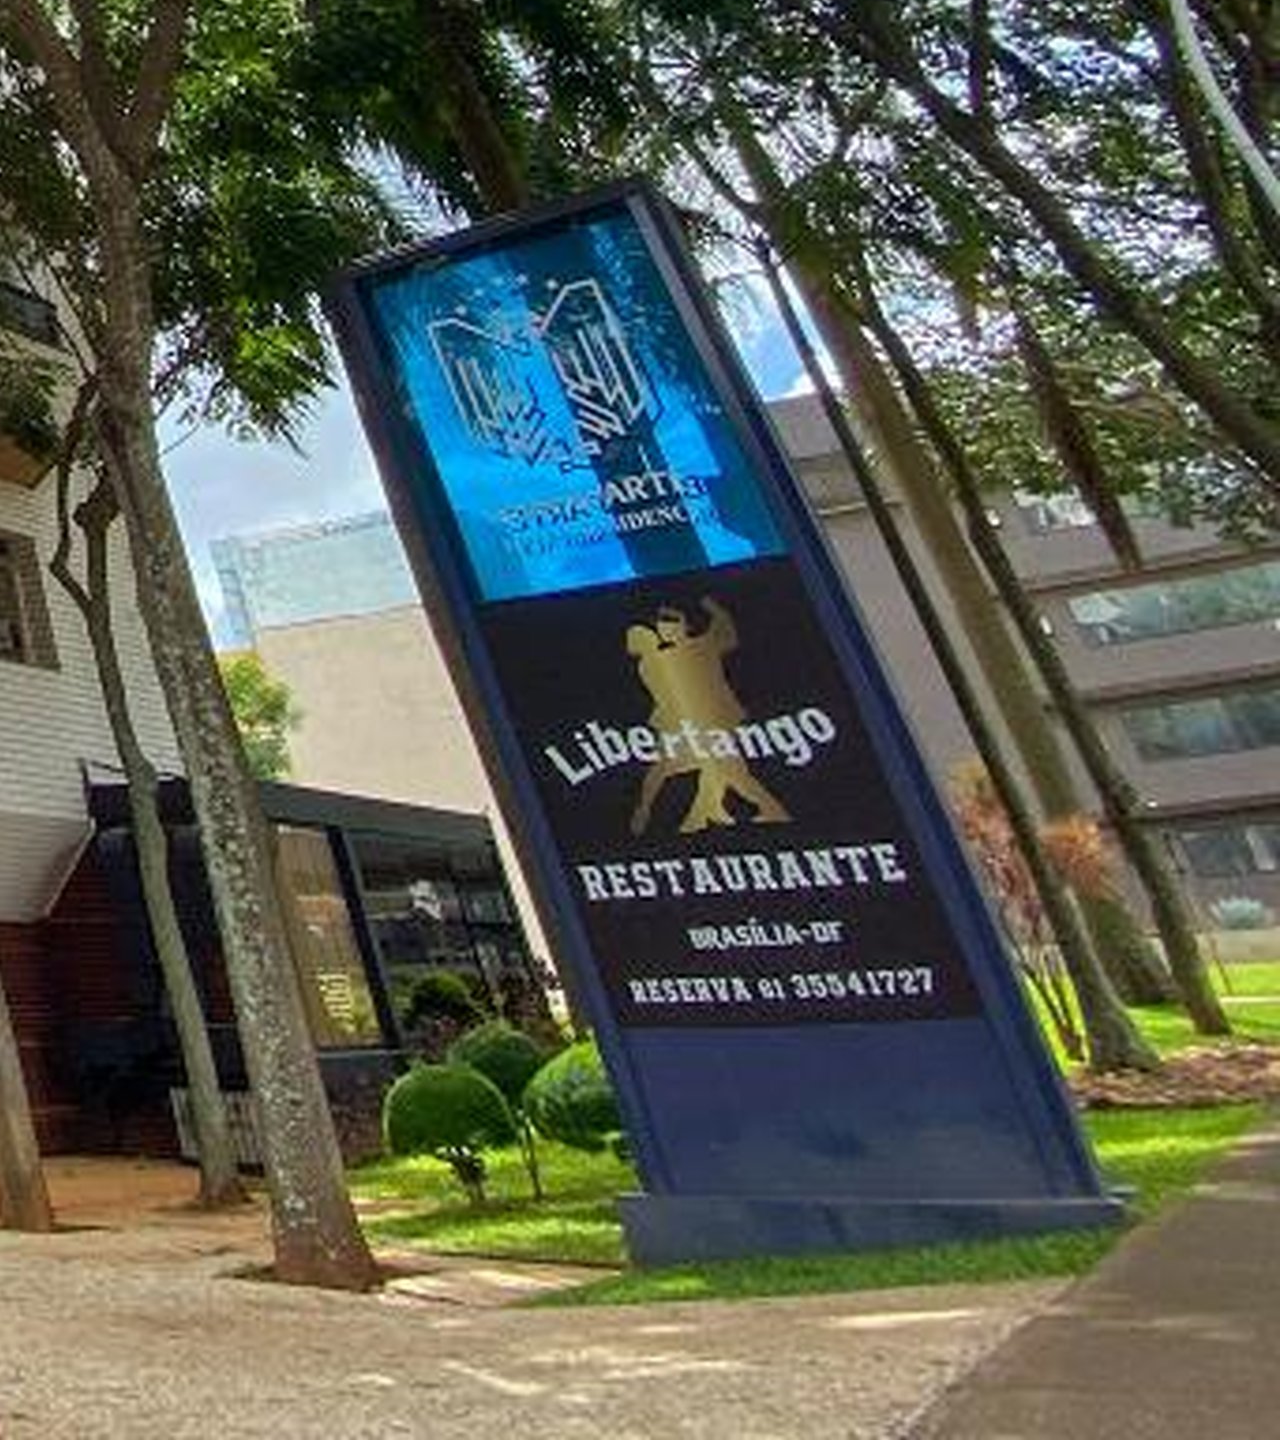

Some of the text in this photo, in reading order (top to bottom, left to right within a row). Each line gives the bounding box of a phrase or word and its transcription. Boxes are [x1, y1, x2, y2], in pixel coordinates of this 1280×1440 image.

[544, 708, 836, 786] Libertango
[577, 843, 907, 900] RESTAURANTE
[629, 977, 754, 1003] RESERVA
